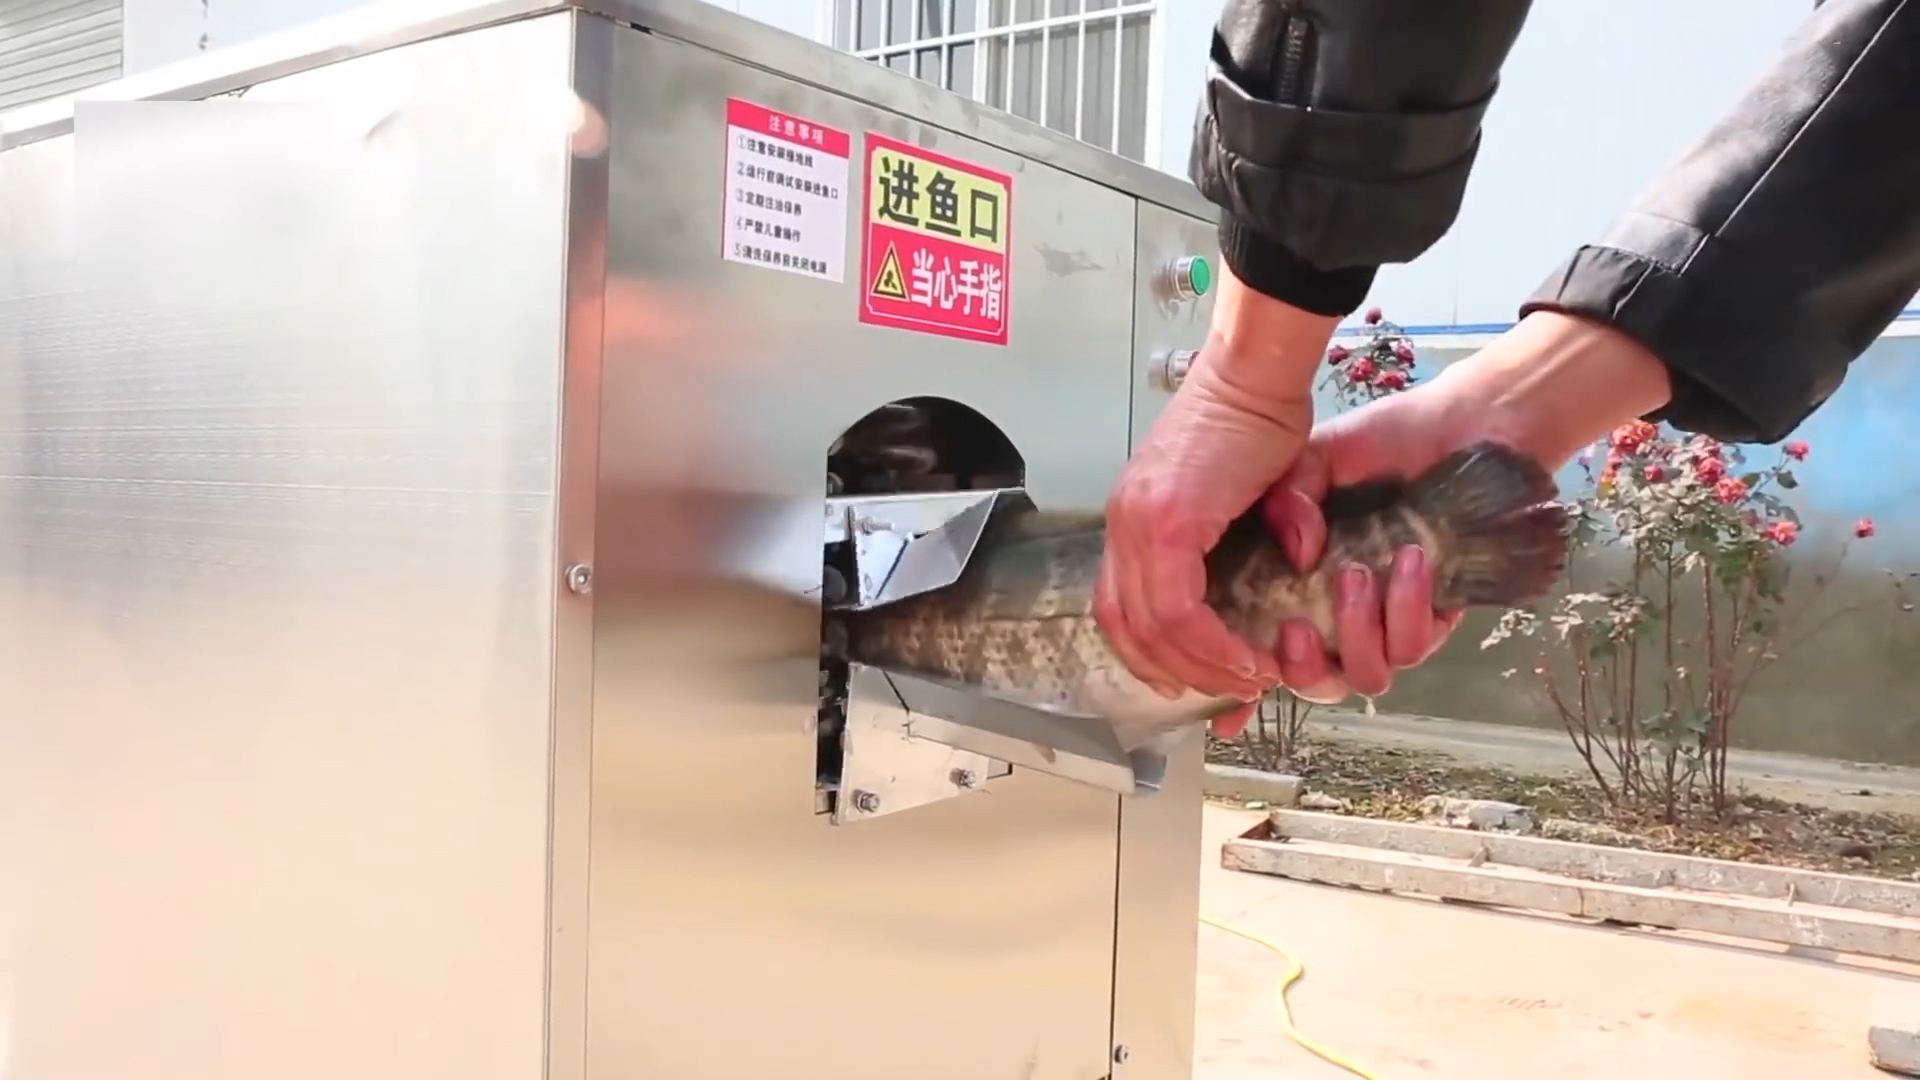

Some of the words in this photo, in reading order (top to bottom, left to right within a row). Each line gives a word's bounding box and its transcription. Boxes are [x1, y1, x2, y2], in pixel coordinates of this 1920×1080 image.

[879, 156, 998, 243] 进鱼口
[911, 248, 1002, 321] 当心手指
